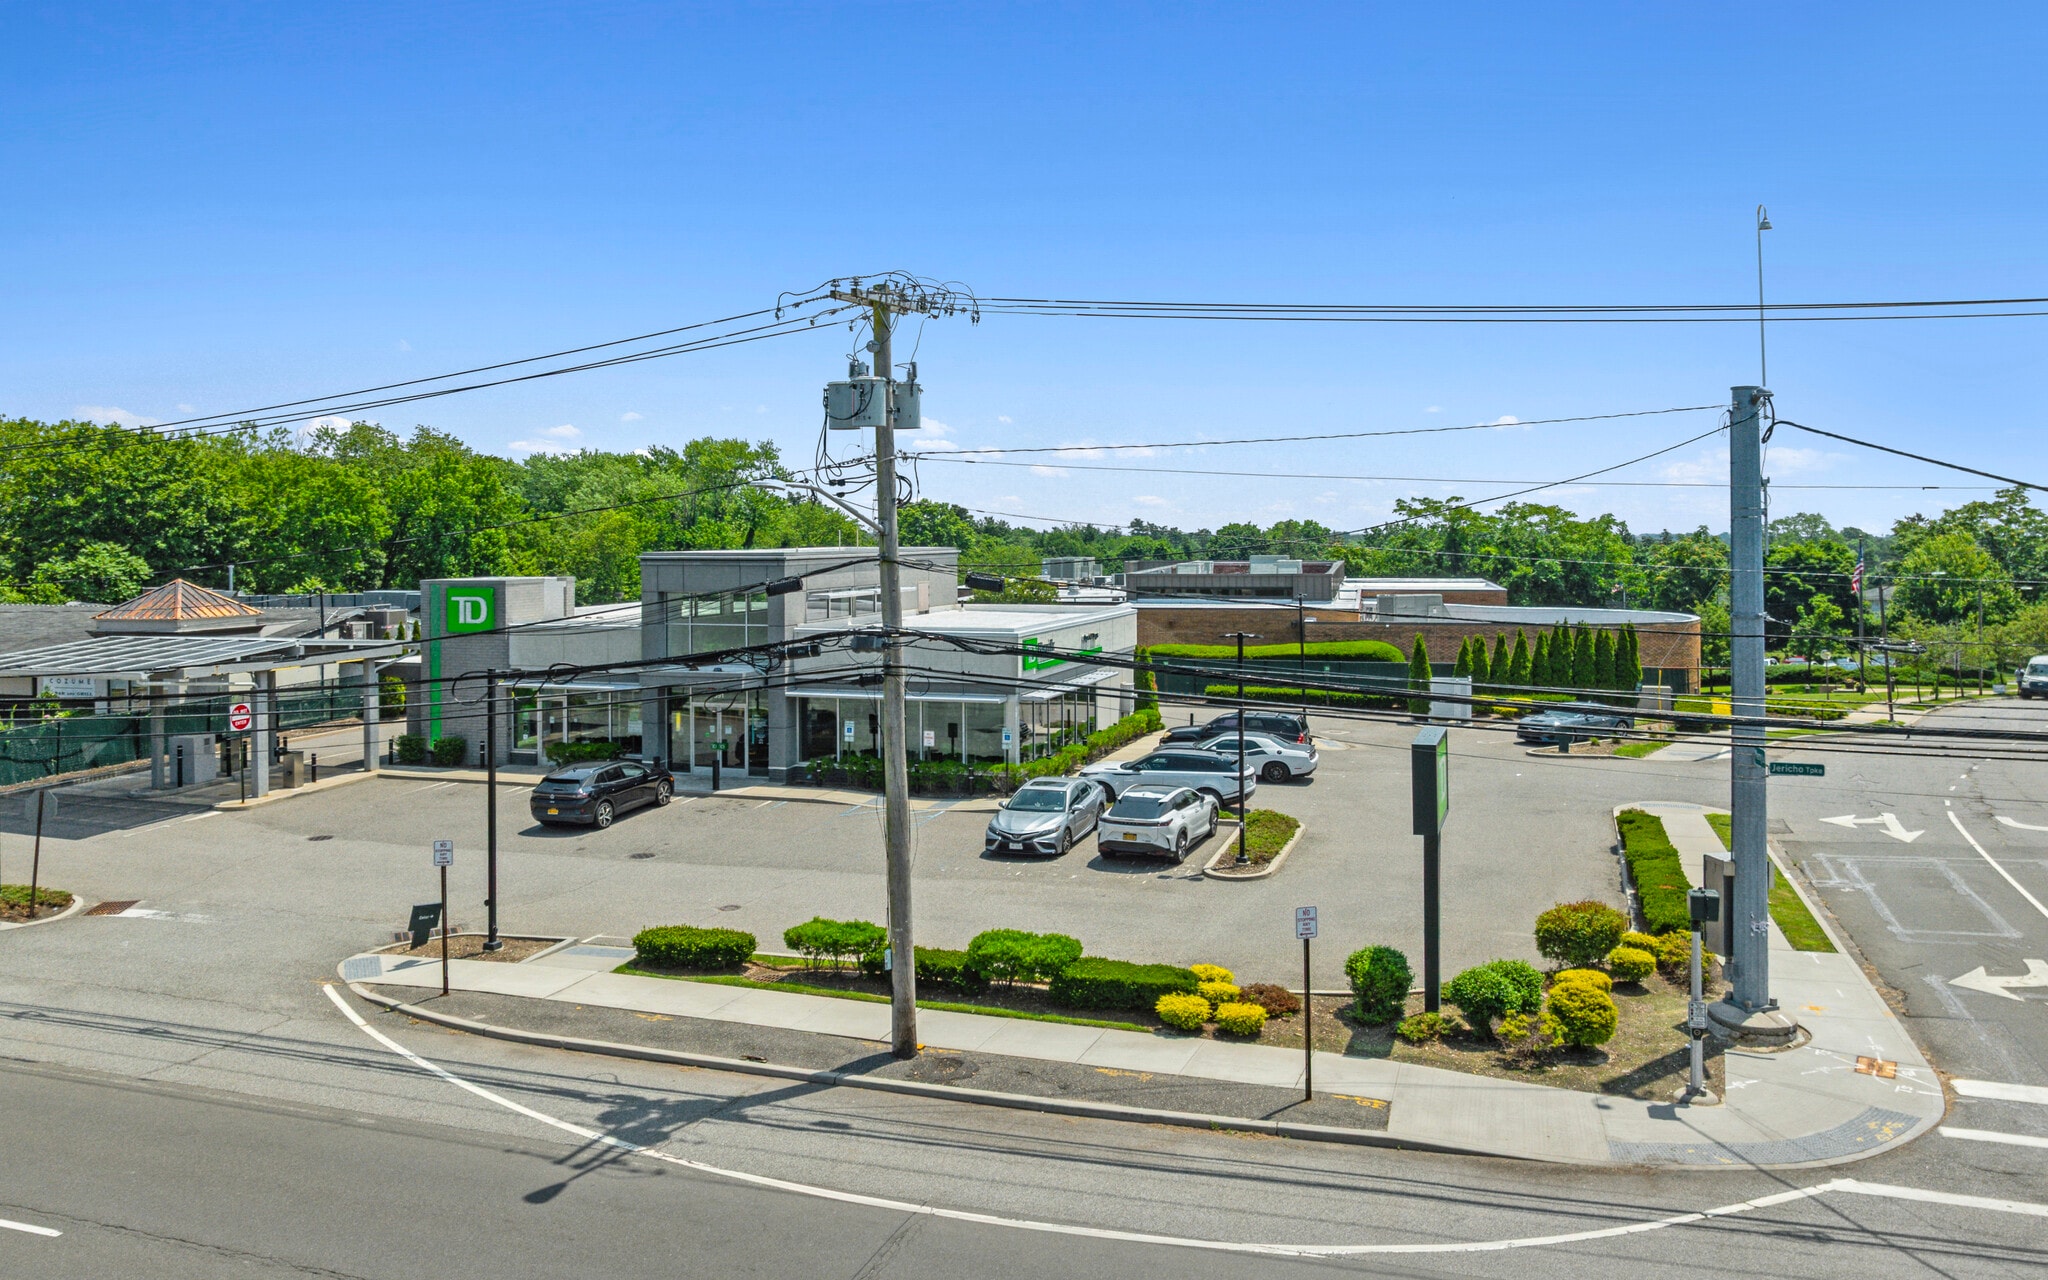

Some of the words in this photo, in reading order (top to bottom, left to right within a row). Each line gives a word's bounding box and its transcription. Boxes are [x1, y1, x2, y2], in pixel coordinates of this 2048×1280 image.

[451, 596, 488, 624] TD
[1771, 764, 1804, 773] Jericho
[1805, 766, 1823, 774] Tpke
[1302, 909, 1311, 917] NO
